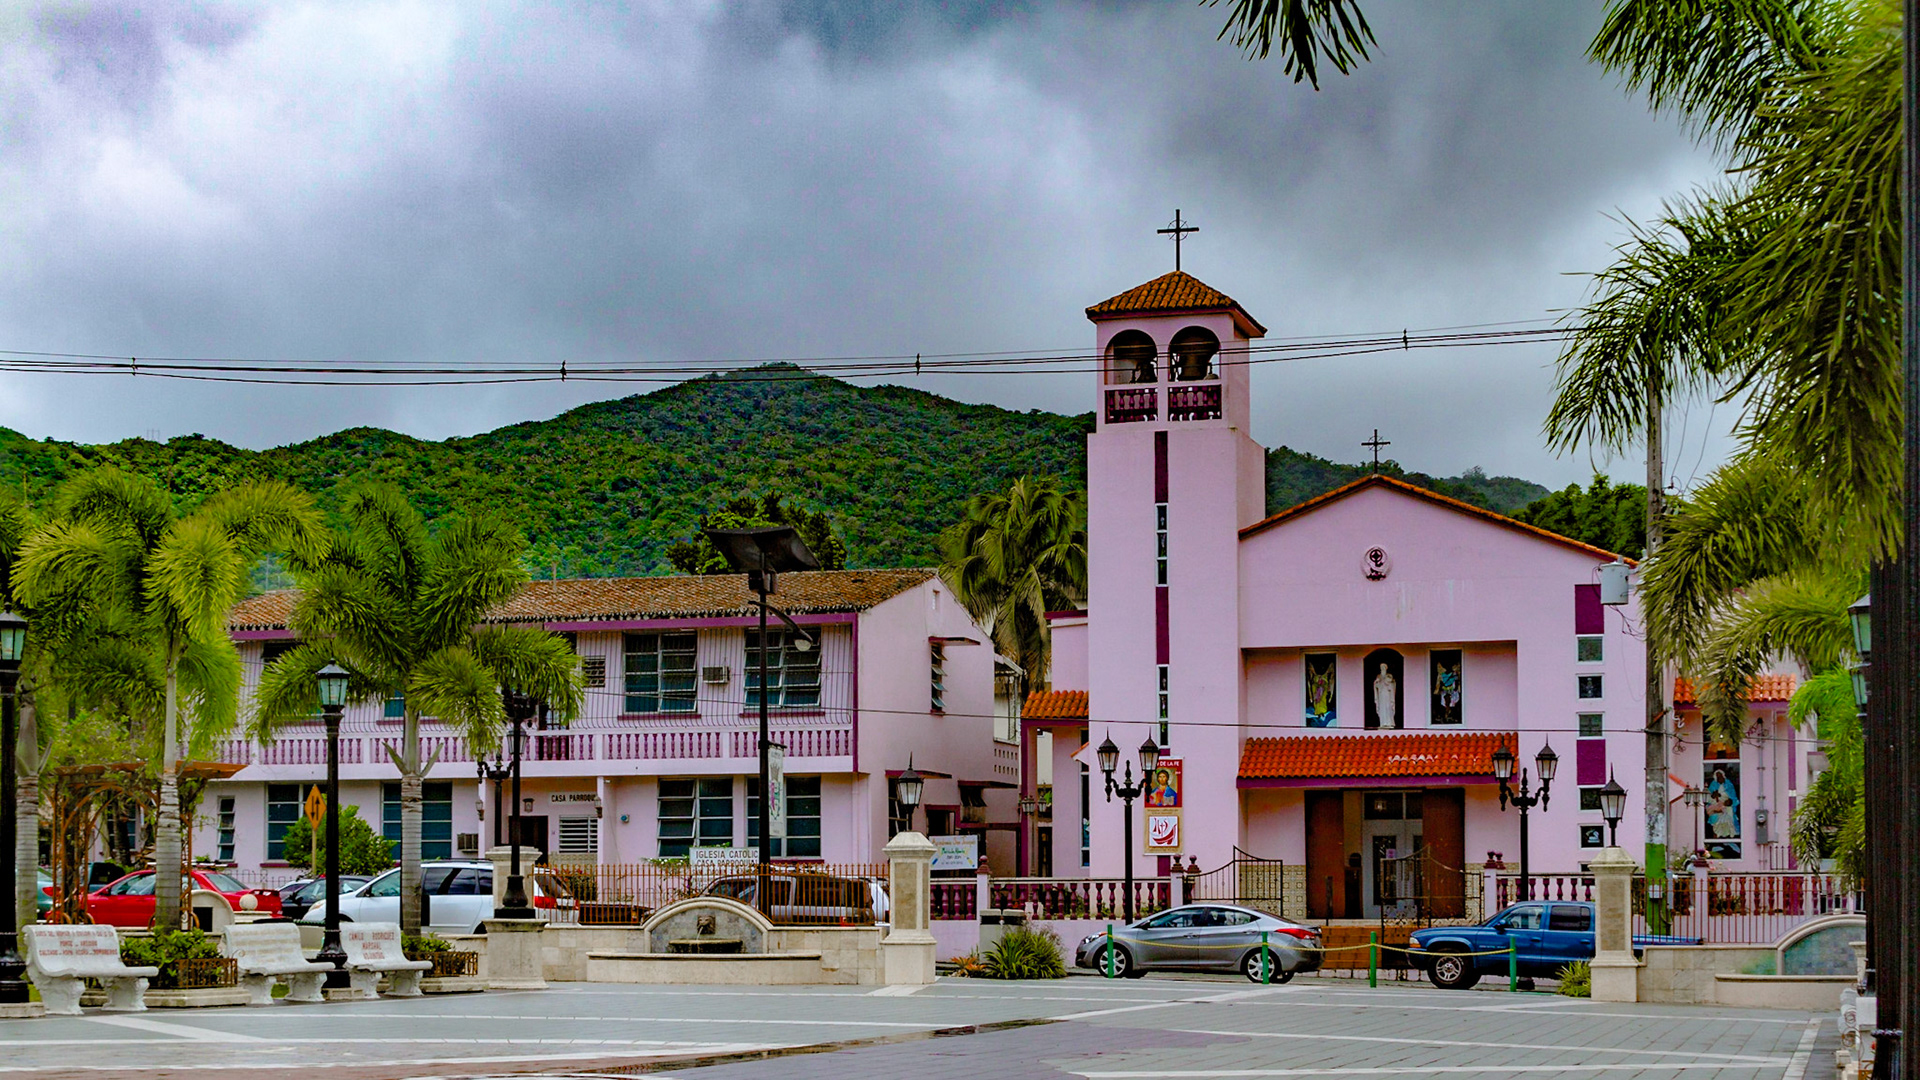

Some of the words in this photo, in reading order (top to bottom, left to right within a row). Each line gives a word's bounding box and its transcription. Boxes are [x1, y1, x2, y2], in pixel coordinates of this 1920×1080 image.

[551, 794, 566, 802] CASA
[569, 794, 596, 802] PARROQU
[695, 850, 726, 859] IGLESIA
[728, 850, 759, 859] CATOLIC
